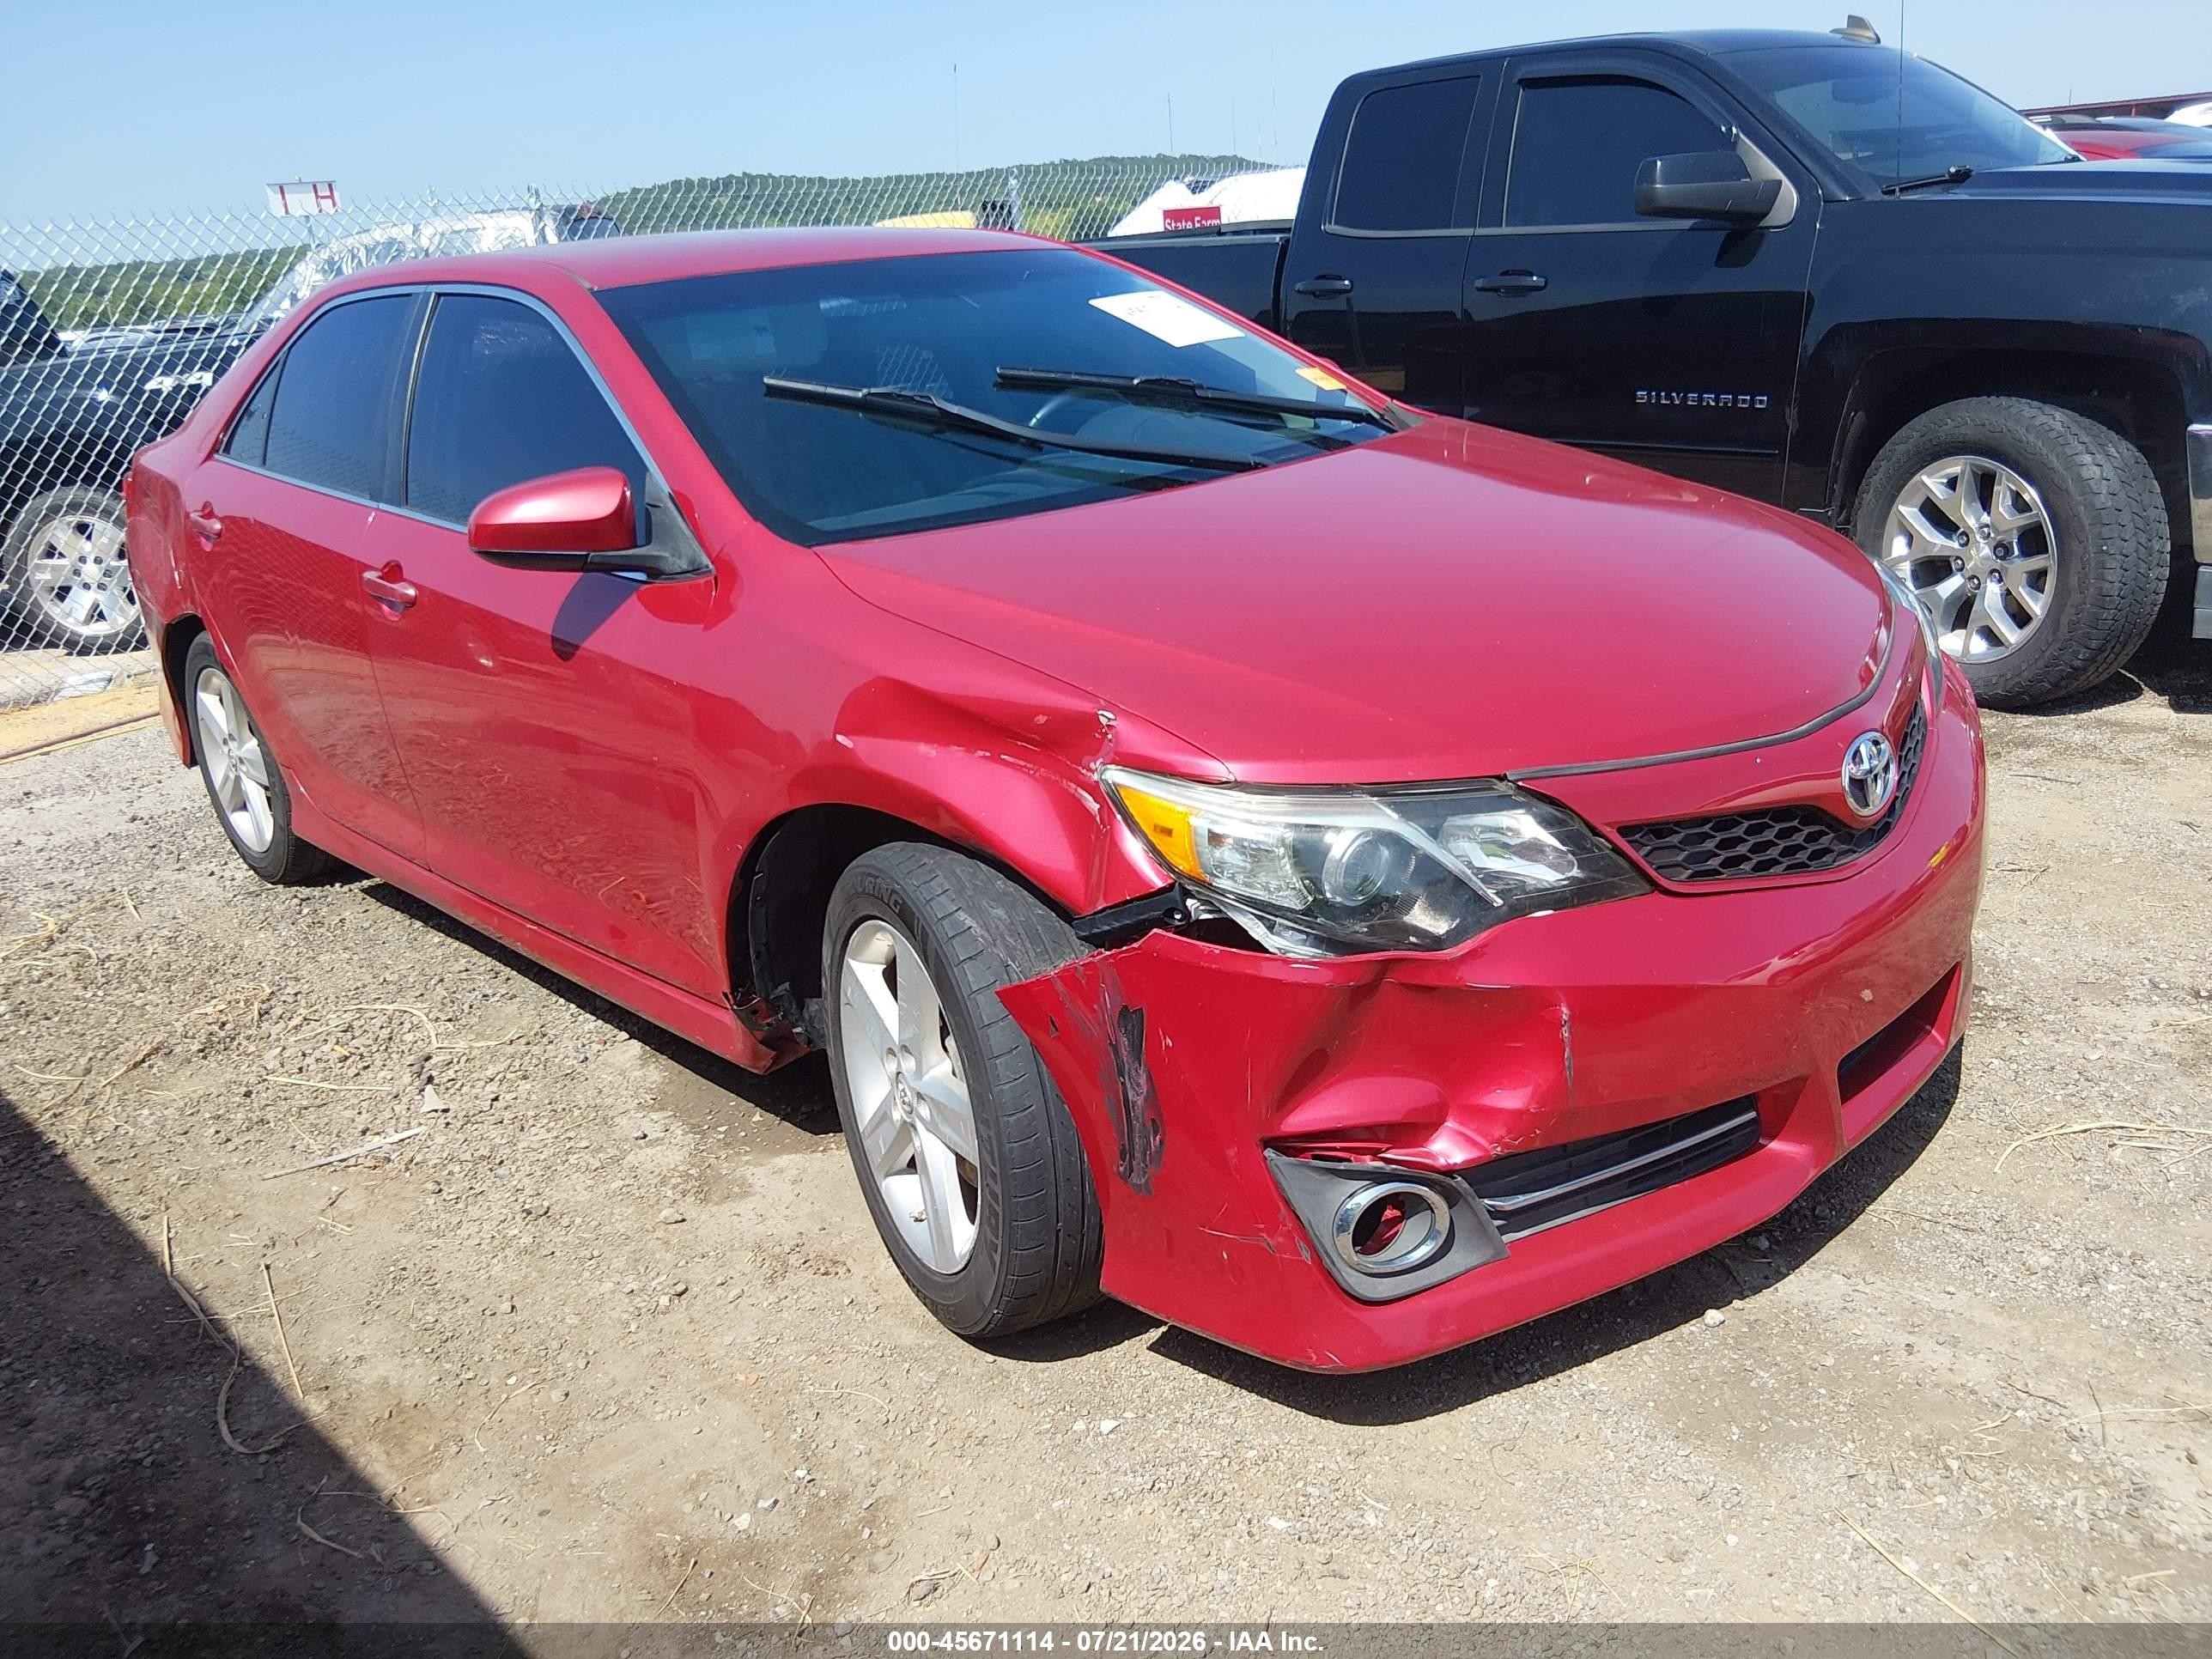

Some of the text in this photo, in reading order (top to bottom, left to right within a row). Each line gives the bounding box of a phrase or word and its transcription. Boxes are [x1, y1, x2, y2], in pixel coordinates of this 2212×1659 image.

[1164, 216, 1220, 232] State Farm
[1635, 390, 1768, 409] SILVERADO
